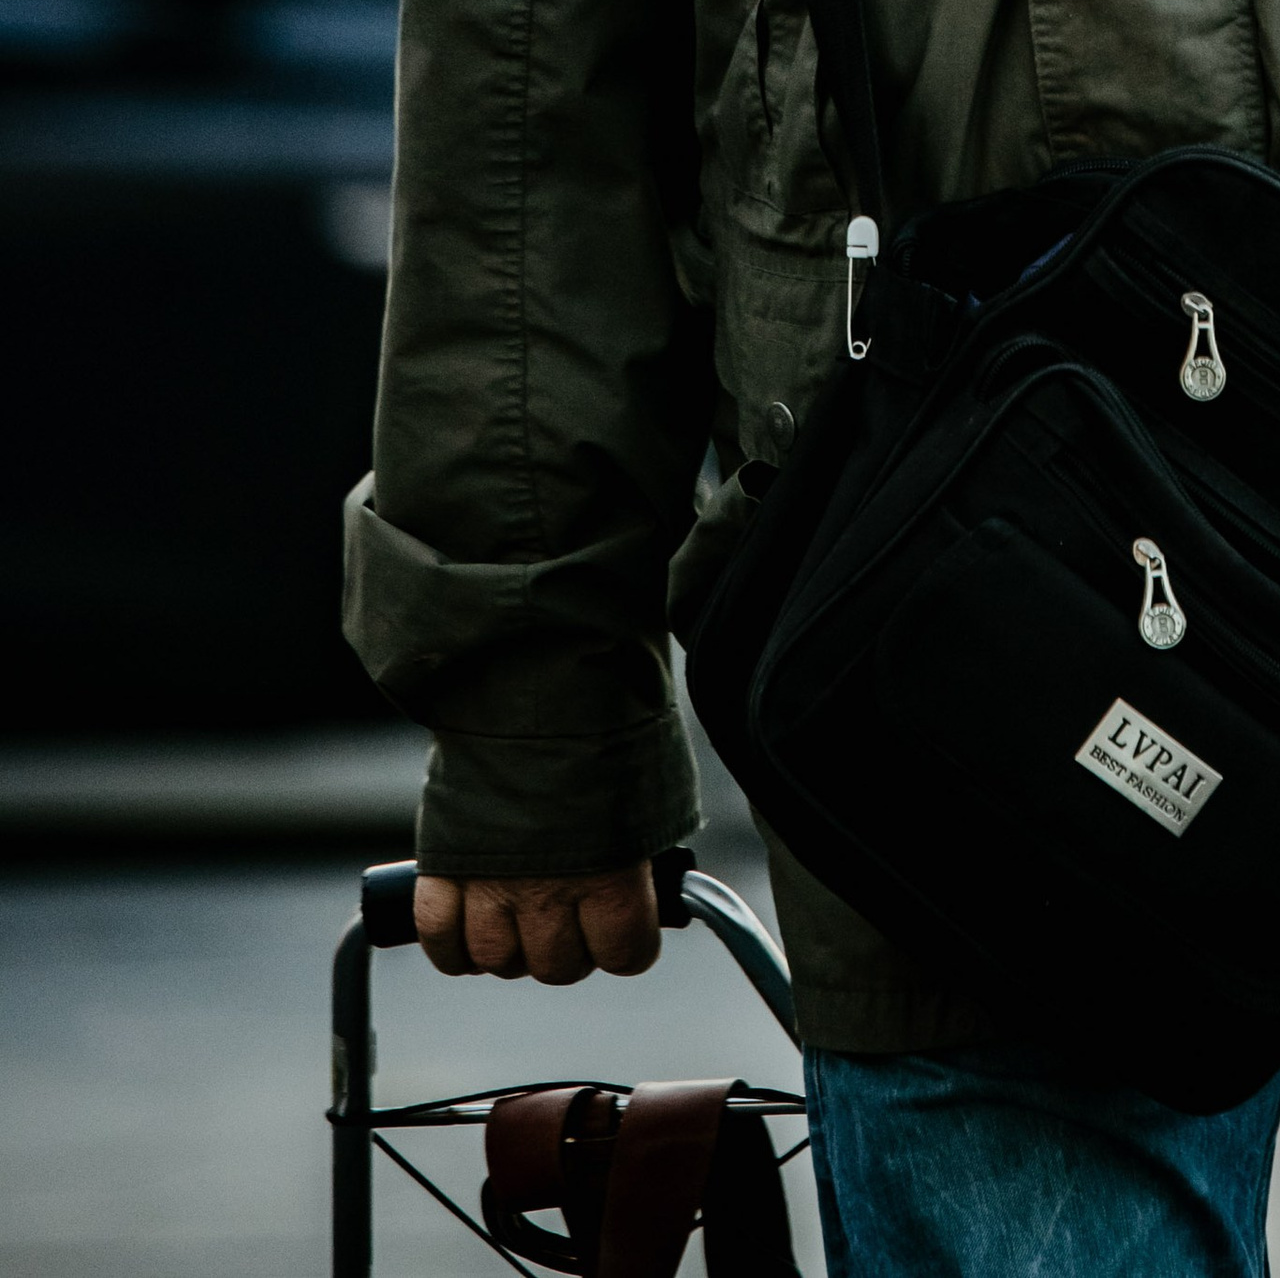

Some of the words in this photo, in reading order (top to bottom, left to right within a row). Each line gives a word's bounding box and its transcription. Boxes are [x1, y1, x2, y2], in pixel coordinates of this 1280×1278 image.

[1089, 744, 1127, 777] BEST
[1125, 772, 1188, 823] FASHION
[1107, 717, 1206, 802] LVPAI
